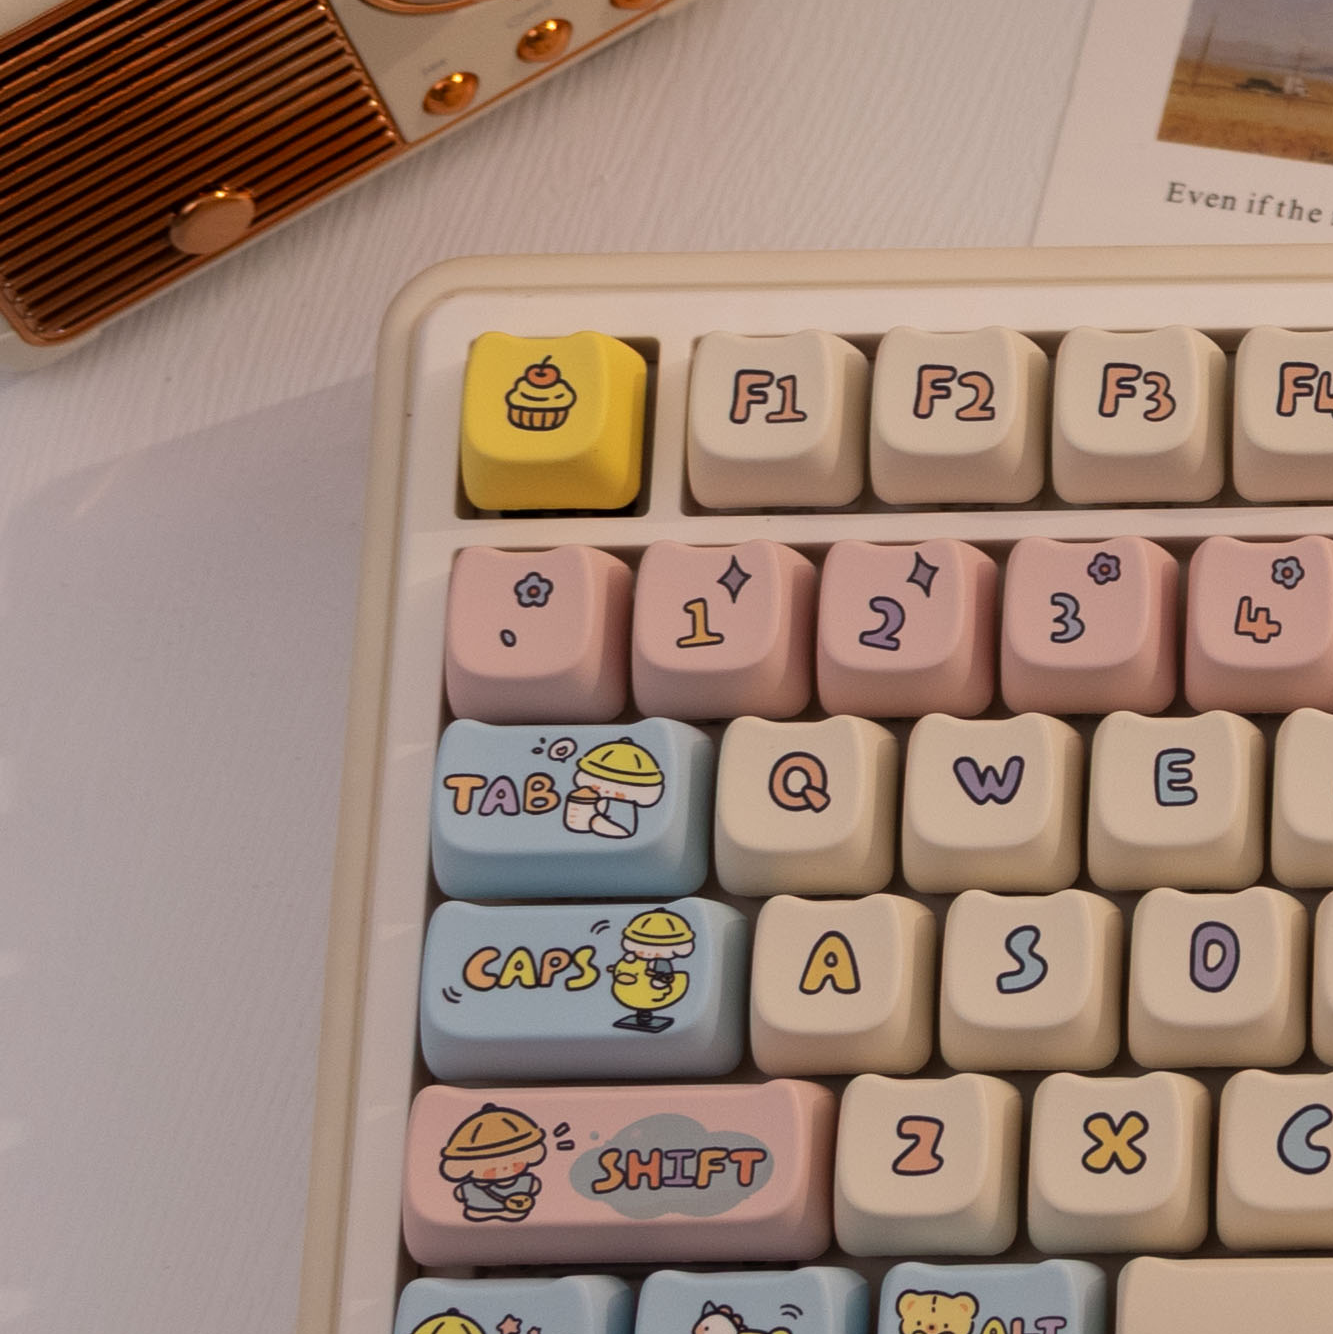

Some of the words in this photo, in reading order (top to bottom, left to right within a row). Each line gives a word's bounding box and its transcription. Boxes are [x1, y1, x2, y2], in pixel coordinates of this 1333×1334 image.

[1165, 180, 1237, 212] Even
[729, 369, 808, 425] F1
[913, 364, 996, 422] F2
[1098, 362, 1177, 422] F3
[674, 598, 725, 649] 1
[858, 595, 906, 652] 2
[1050, 592, 1086, 644] 3
[1234, 595, 1282, 644] 4
[444, 772, 557, 817] TAB
[768, 751, 831, 814] Q
[952, 755, 1025, 806] W
[1153, 747, 1198, 807] E
[461, 944, 601, 991] CAPS
[798, 930, 861, 996] A
[996, 924, 1049, 995] S
[1189, 920, 1241, 994] D
[891, 1115, 945, 1177] Z
[1081, 1110, 1150, 1175] X
[1276, 1103, 1333, 1176] C
[591, 1146, 768, 1195] SHIFT
